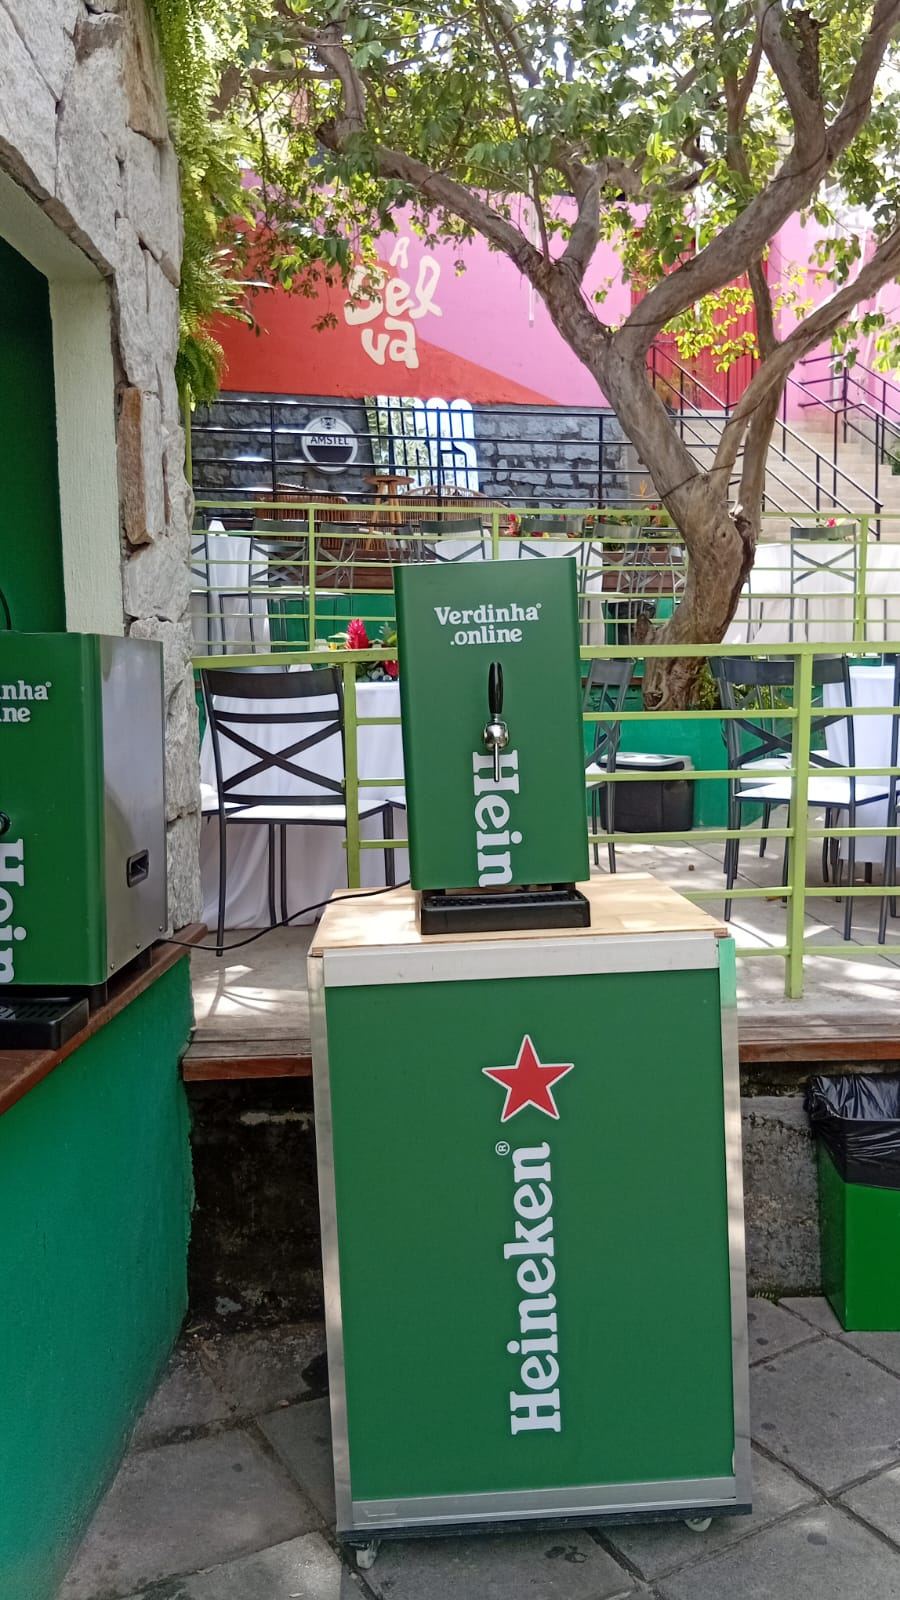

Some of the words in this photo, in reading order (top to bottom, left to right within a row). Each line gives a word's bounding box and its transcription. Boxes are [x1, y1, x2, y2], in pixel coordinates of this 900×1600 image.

[388, 236, 410, 269] A
[361, 316, 420, 369] va
[310, 434, 349, 445] AMSTEL
[450, 624, 523, 646] .online
[472, 749, 523, 888] Hein
